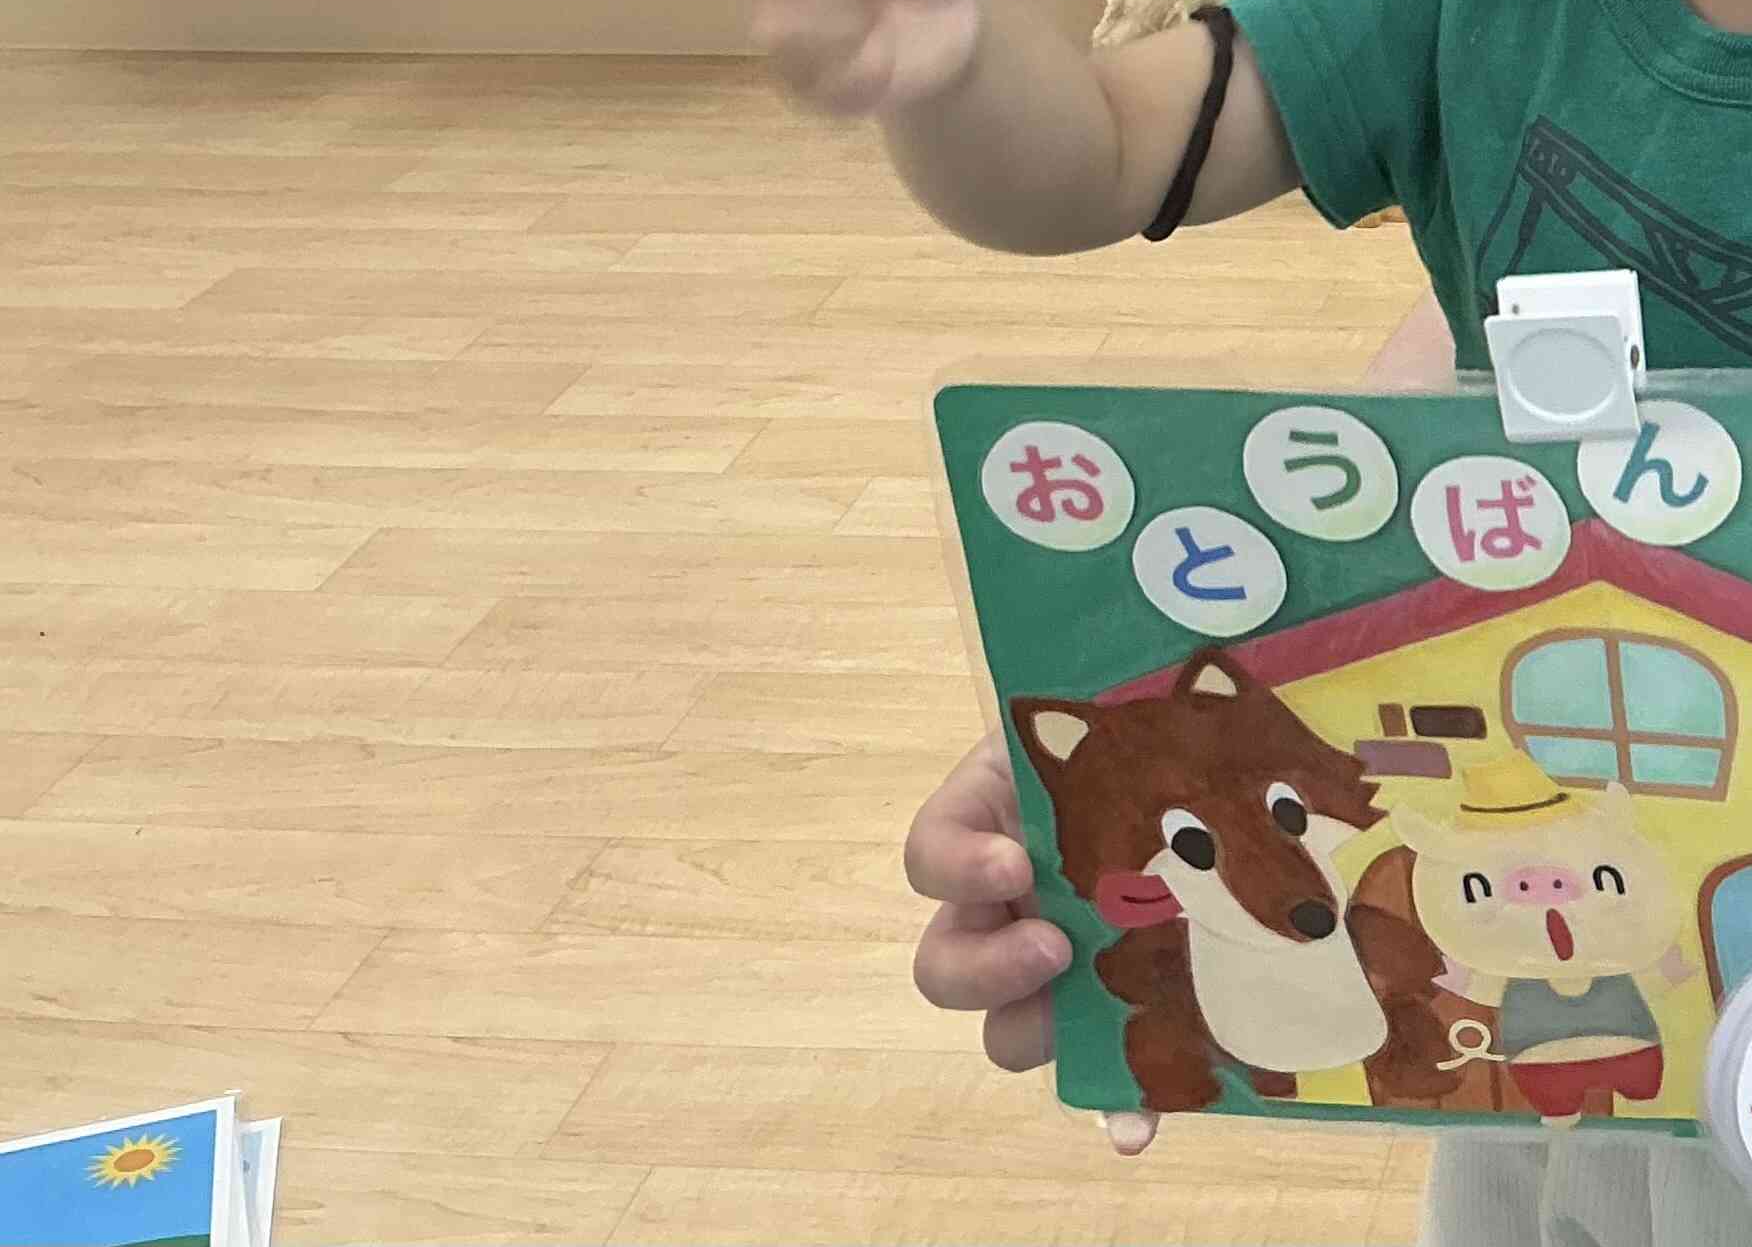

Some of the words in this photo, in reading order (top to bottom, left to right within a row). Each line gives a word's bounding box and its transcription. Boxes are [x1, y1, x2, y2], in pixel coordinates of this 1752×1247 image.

[1009, 421, 1708, 602] おとうばん
